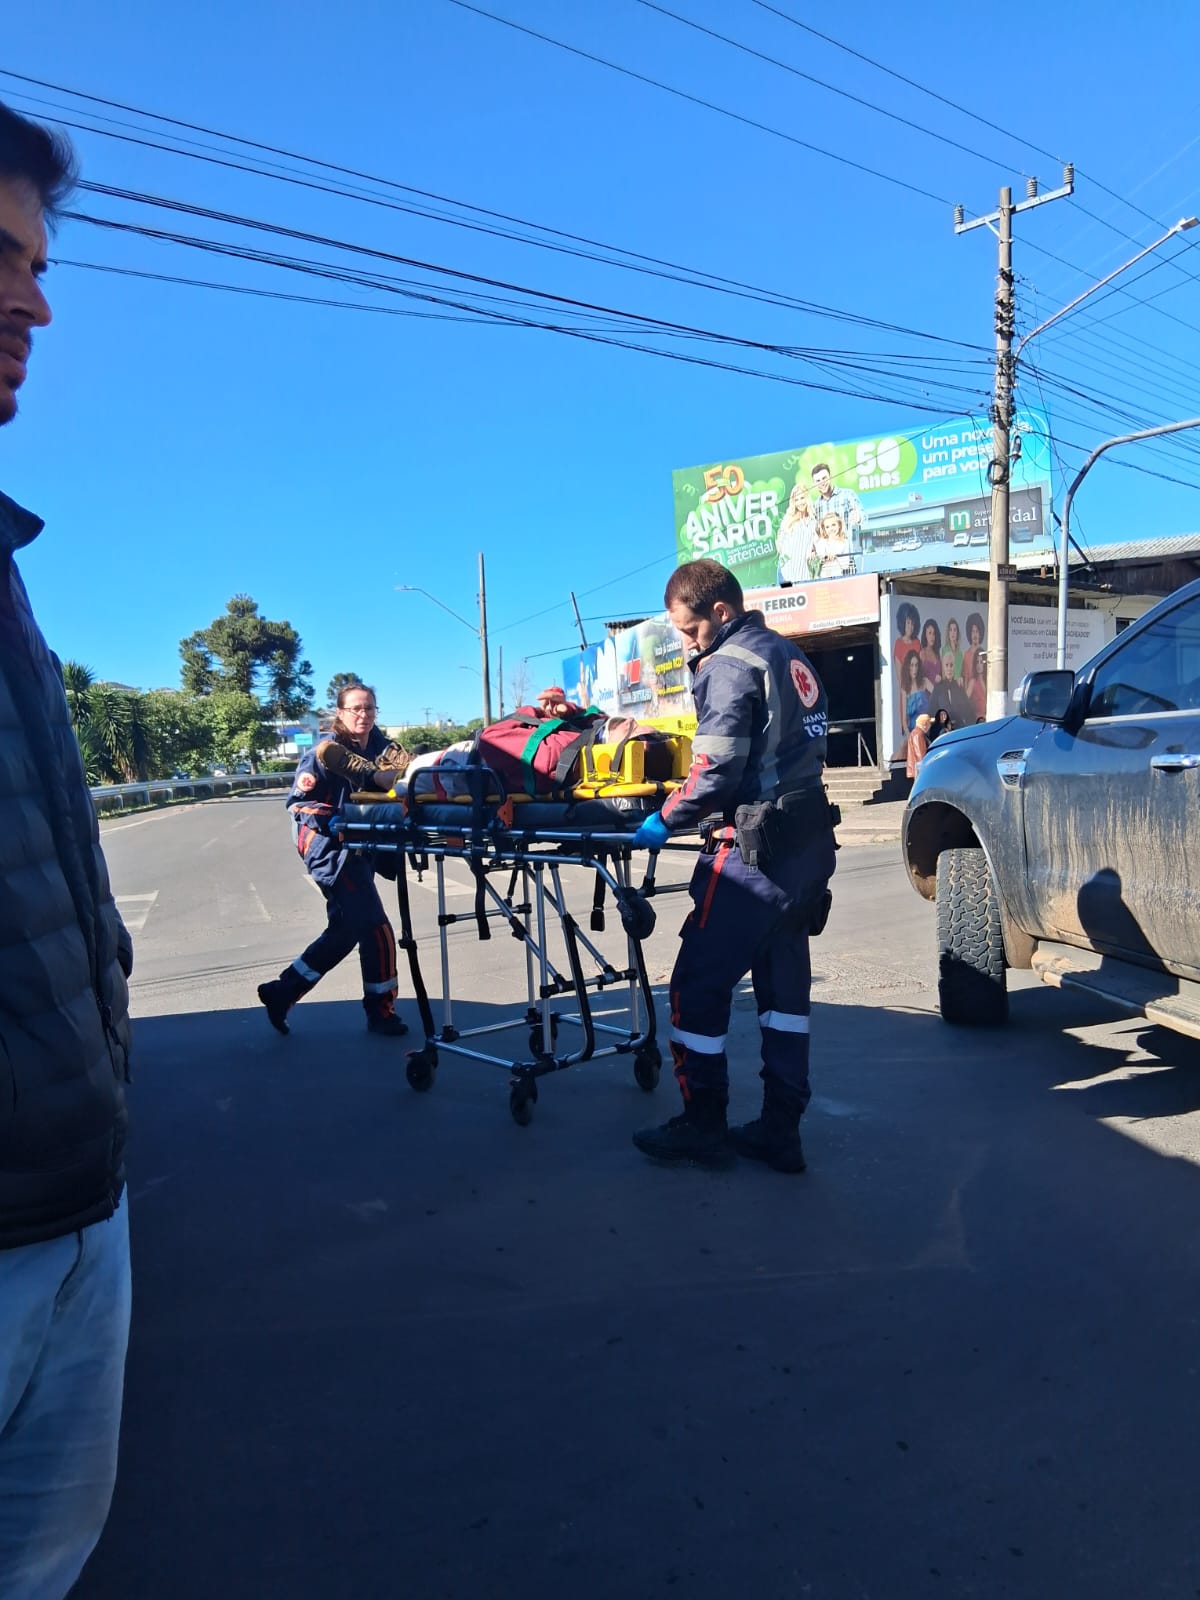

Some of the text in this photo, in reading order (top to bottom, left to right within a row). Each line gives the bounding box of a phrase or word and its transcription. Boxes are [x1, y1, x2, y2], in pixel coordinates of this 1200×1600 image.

[922, 433, 958, 450] Uma
[855, 438, 901, 475] 50
[922, 443, 994, 464] um prese
[858, 471, 901, 490] anos
[922, 458, 988, 482] para voc
[703, 464, 745, 503] 50
[686, 490, 779, 541] ANIVER
[974, 506, 1037, 527] artdal
[727, 541, 774, 566] artendal
[765, 595, 806, 611] FERRO
[803, 712, 827, 724] SAMU
